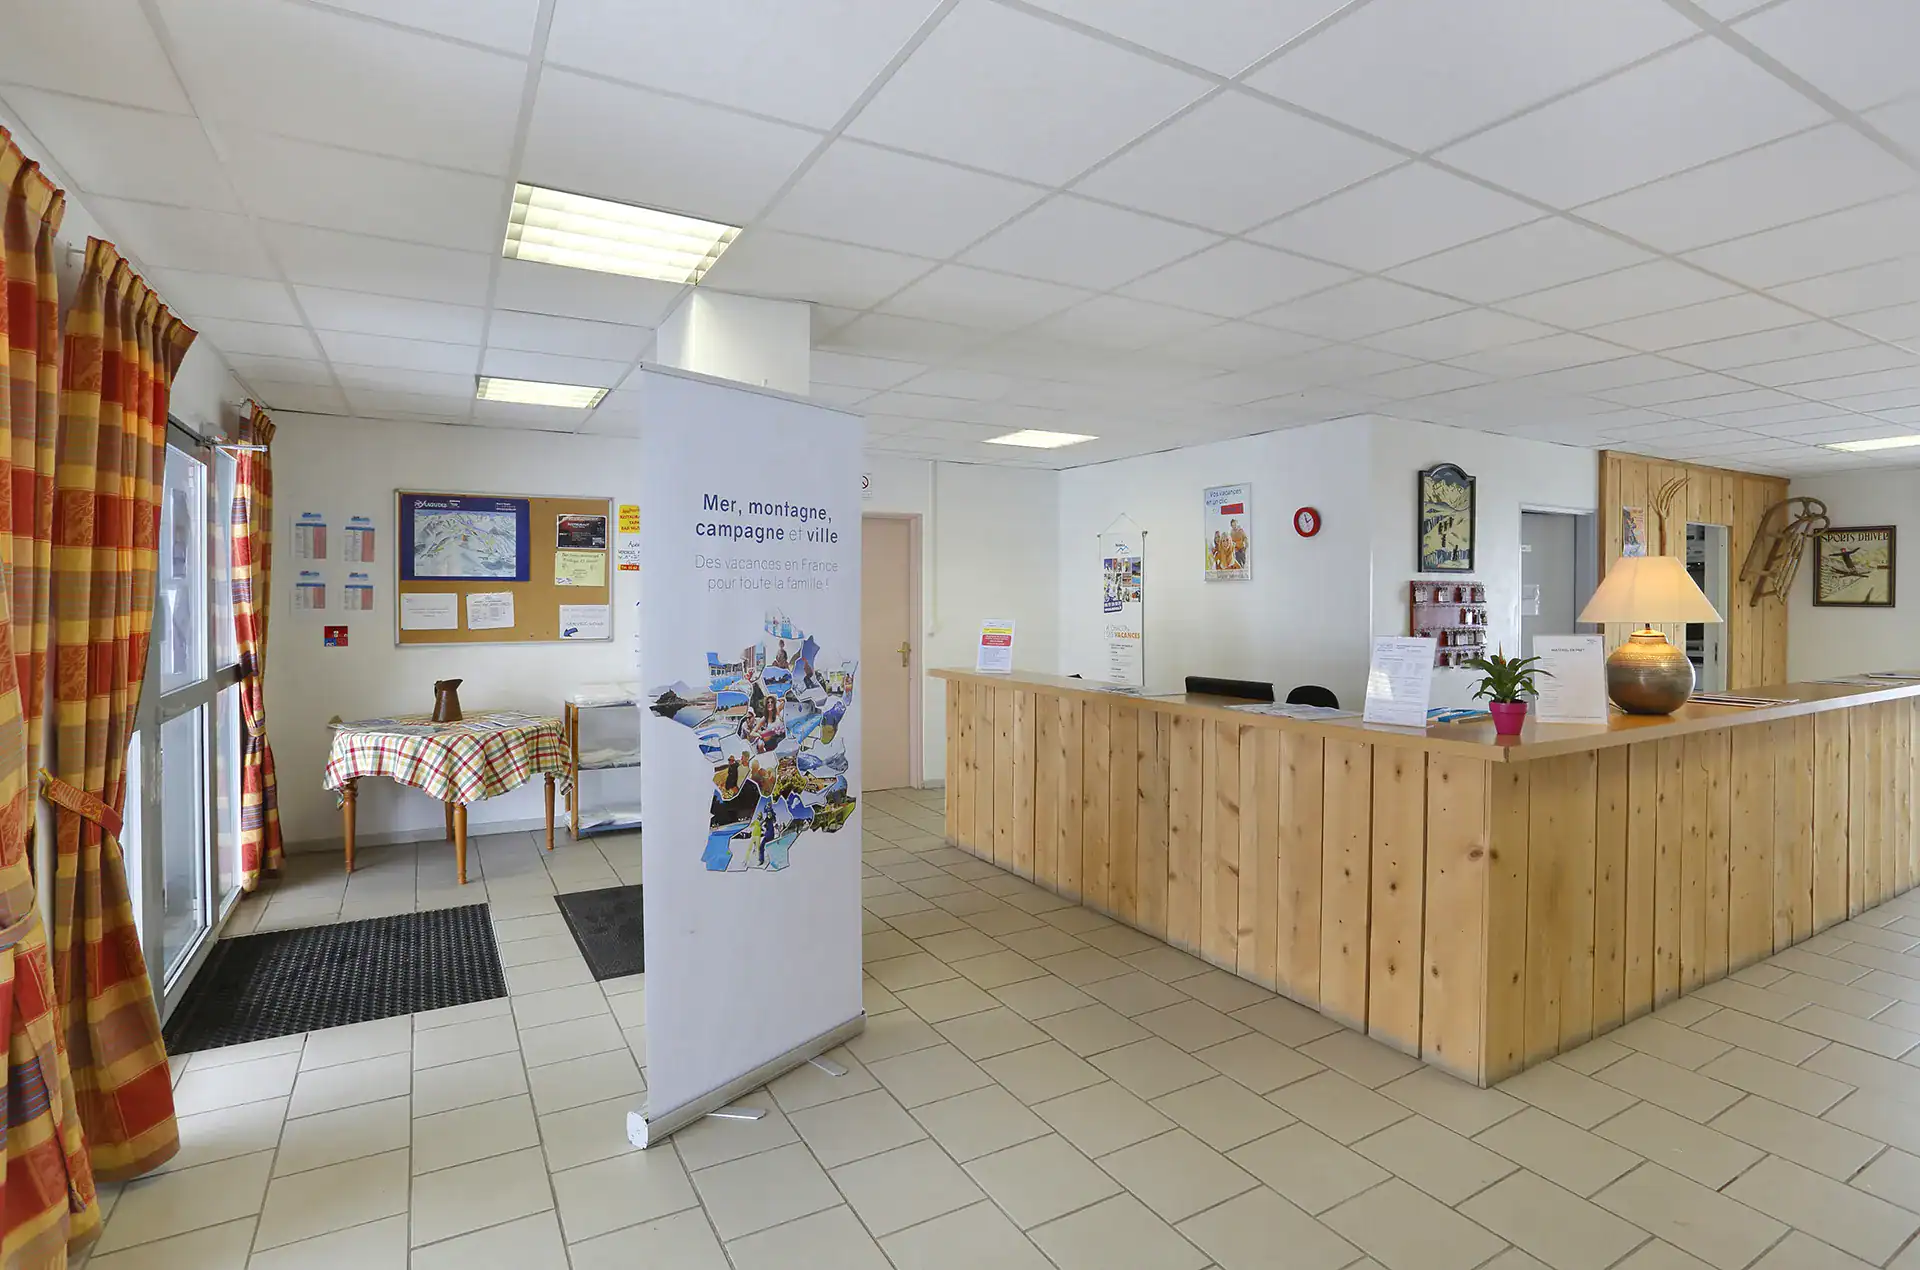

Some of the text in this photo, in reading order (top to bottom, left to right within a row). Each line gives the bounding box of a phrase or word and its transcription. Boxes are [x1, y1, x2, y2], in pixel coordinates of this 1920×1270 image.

[703, 493, 832, 524] Mer, montagne,
[695, 522, 838, 544] campagne et ville
[1821, 533, 1855, 543] SPORTS
[695, 554, 838, 572] Des vacances en France
[708, 578, 737, 592] pour
[740, 576, 771, 590] toute
[775, 576, 784, 589] la
[787, 577, 823, 590] famille
[1114, 631, 1141, 639] VACANCES
